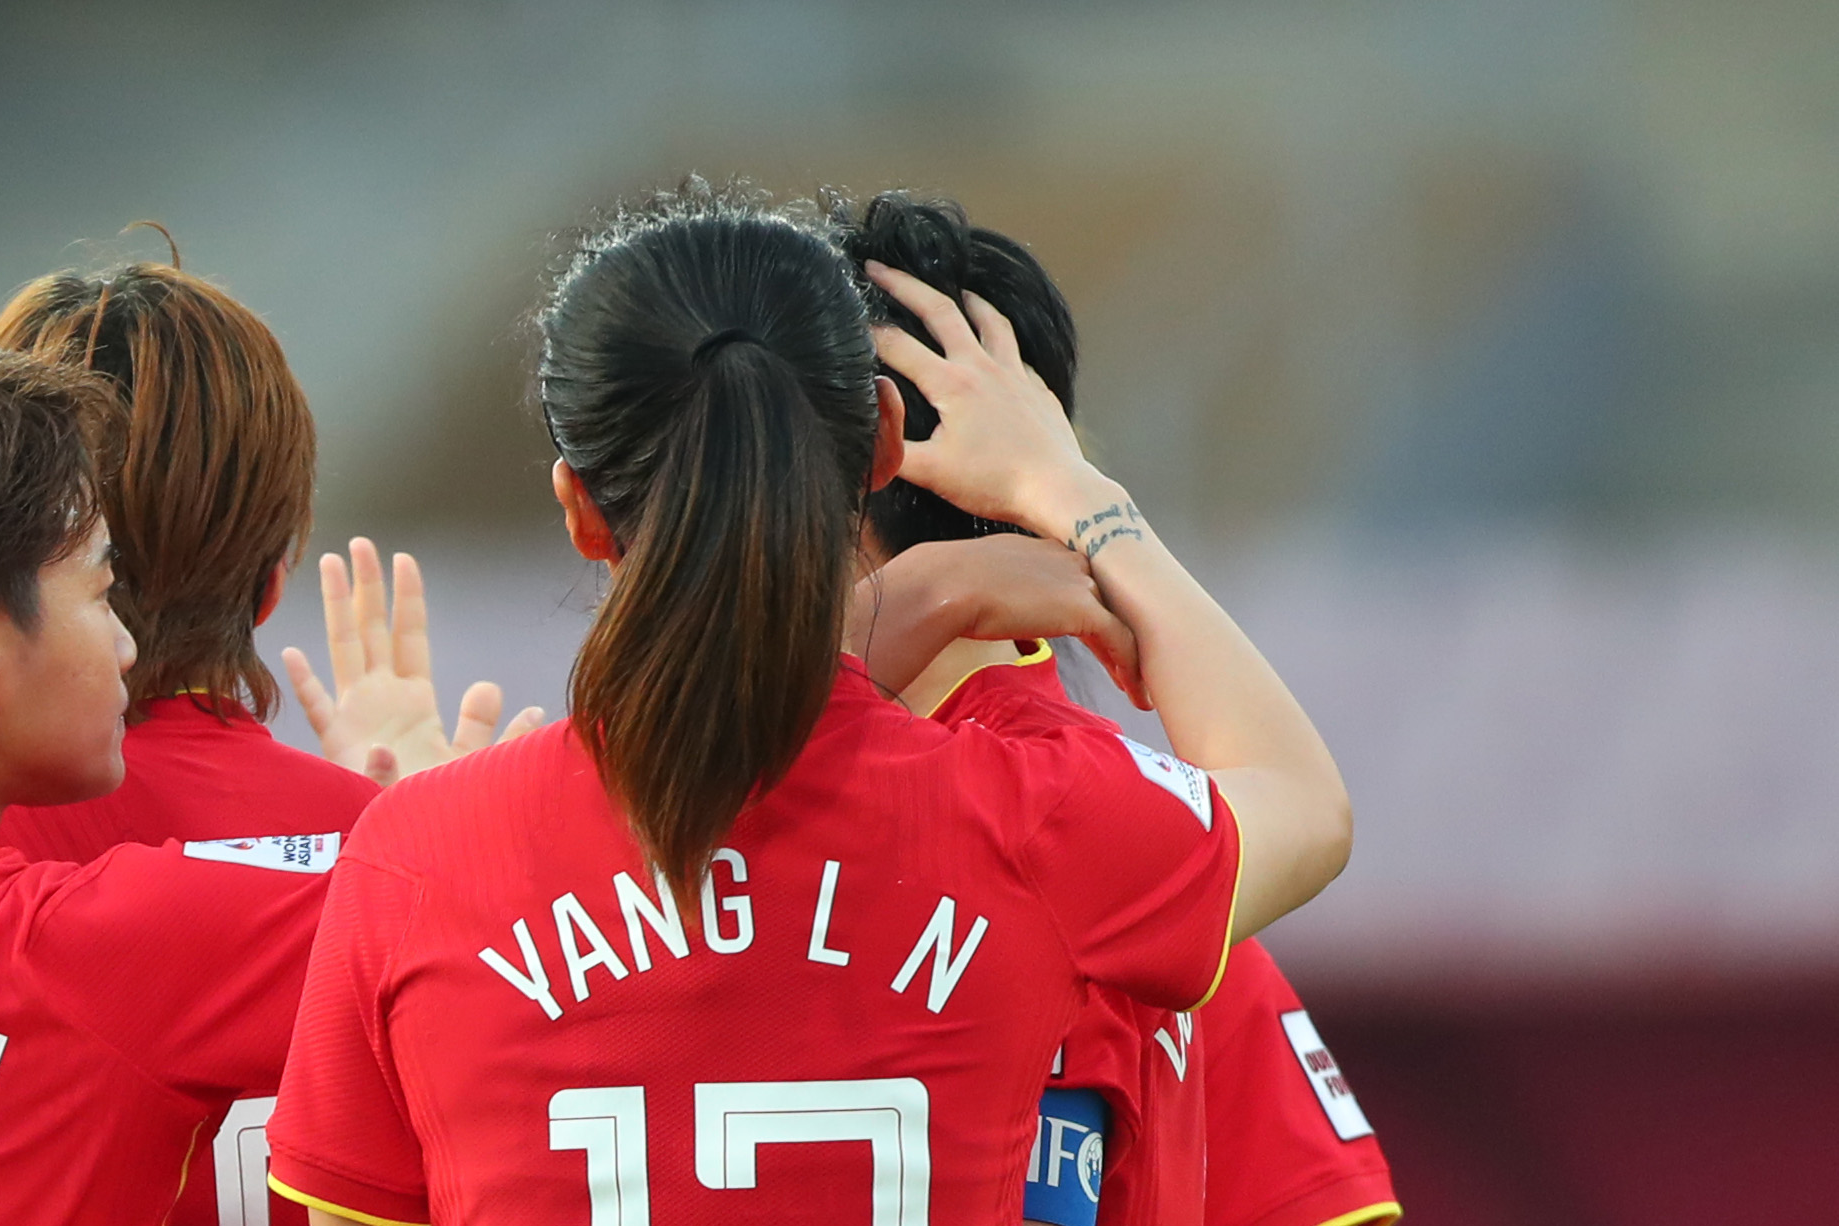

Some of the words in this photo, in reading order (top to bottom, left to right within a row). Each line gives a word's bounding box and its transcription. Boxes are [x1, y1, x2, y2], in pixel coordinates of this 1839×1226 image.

[478, 847, 754, 1020] YANG
[807, 860, 850, 966] L
[890, 896, 989, 1015] N
[1027, 1115, 1105, 1203] FC
